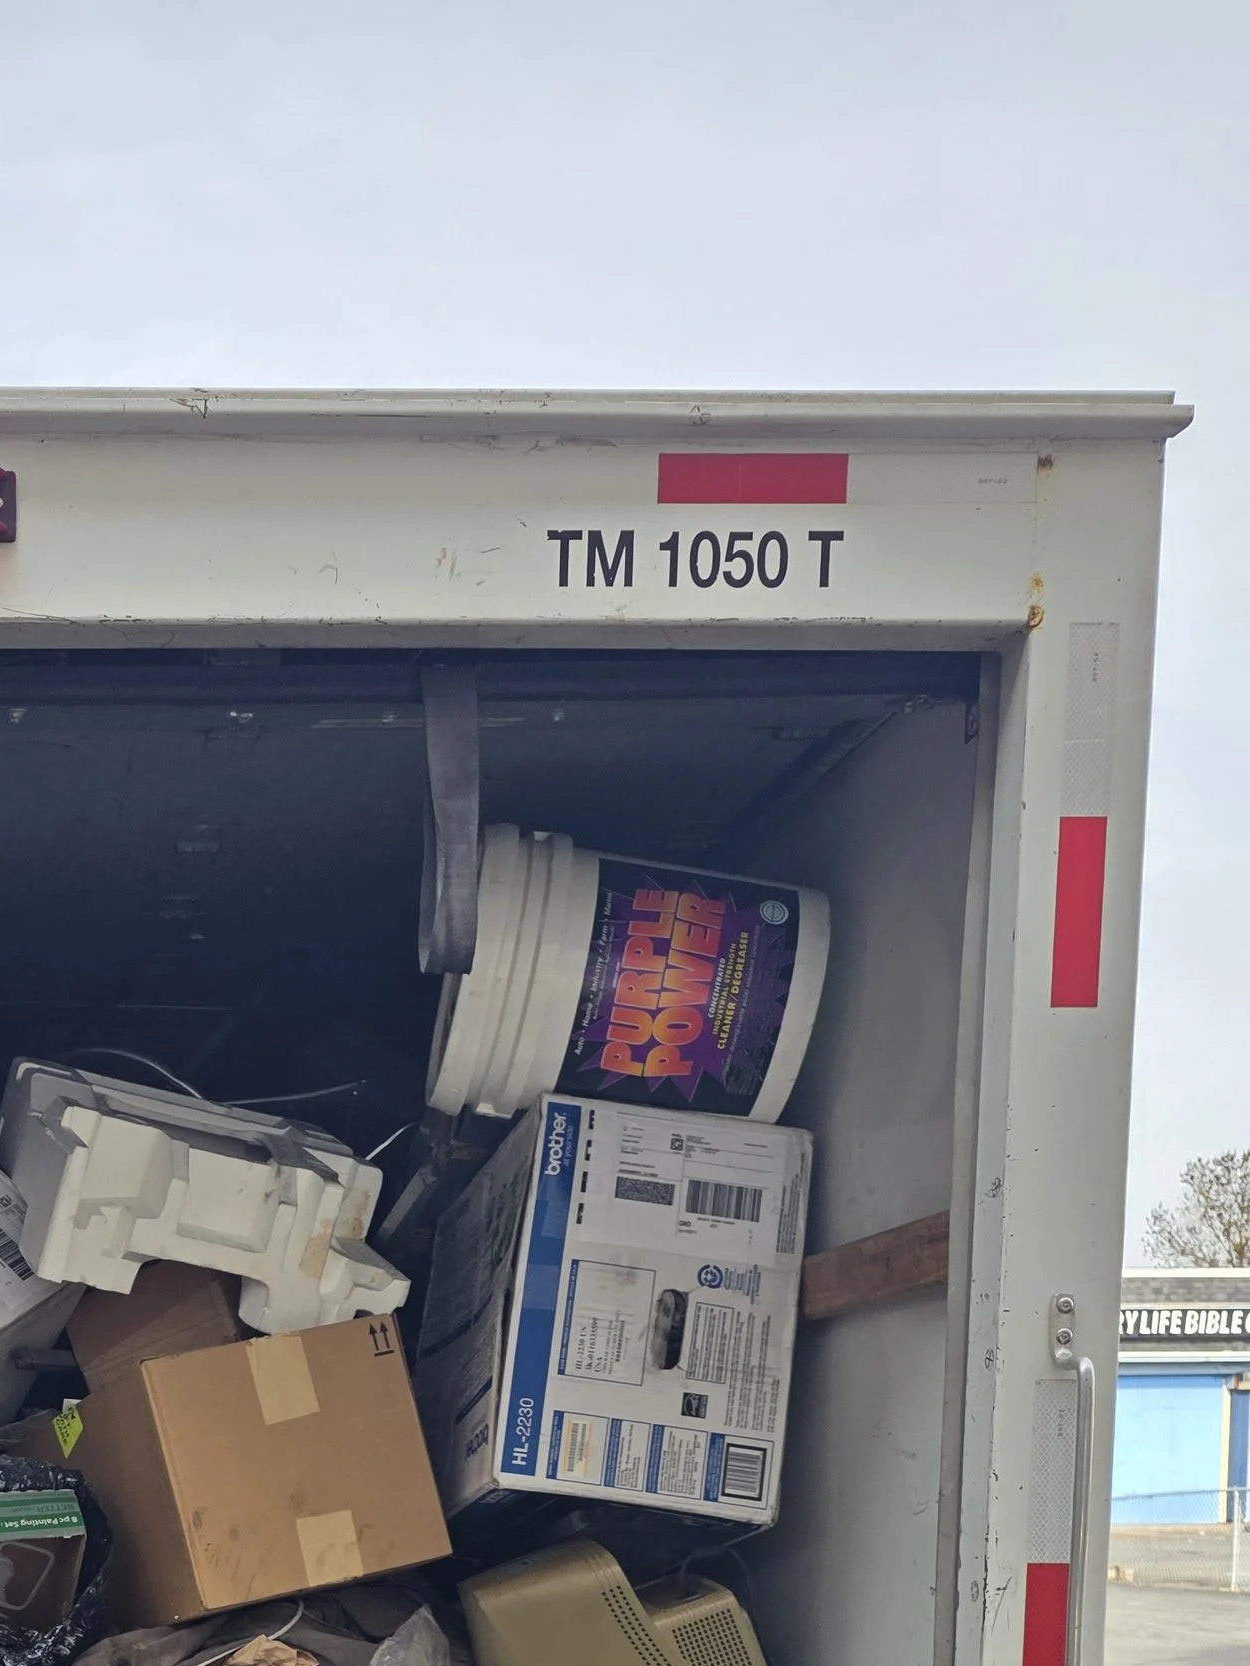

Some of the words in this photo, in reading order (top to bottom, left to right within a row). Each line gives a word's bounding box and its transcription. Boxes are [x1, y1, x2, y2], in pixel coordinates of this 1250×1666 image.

[548, 529, 636, 588] TM
[659, 530, 791, 588] 1050
[799, 530, 844, 588] T
[575, 1037, 586, 1055] Auto
[582, 1003, 594, 1028] Home
[590, 956, 604, 993] Industry
[600, 925, 609, 947] Farm
[600, 888, 679, 1078] PURPLE
[643, 892, 726, 1078] POWER
[708, 957, 726, 1019] CONCENTRATED
[714, 987, 731, 1036] INDUSTRIAL
[725, 943, 737, 985] STRENGTH
[544, 1111, 568, 1177] brother
[1139, 1310, 1183, 1335] LIFE
[1184, 1310, 1244, 1335] BIBLE
[512, 1397, 535, 1467] HL-2230
[4, 1520, 20, 1528] Set
[20, 1517, 59, 1528] Painting
[59, 1515, 71, 1525] pc
